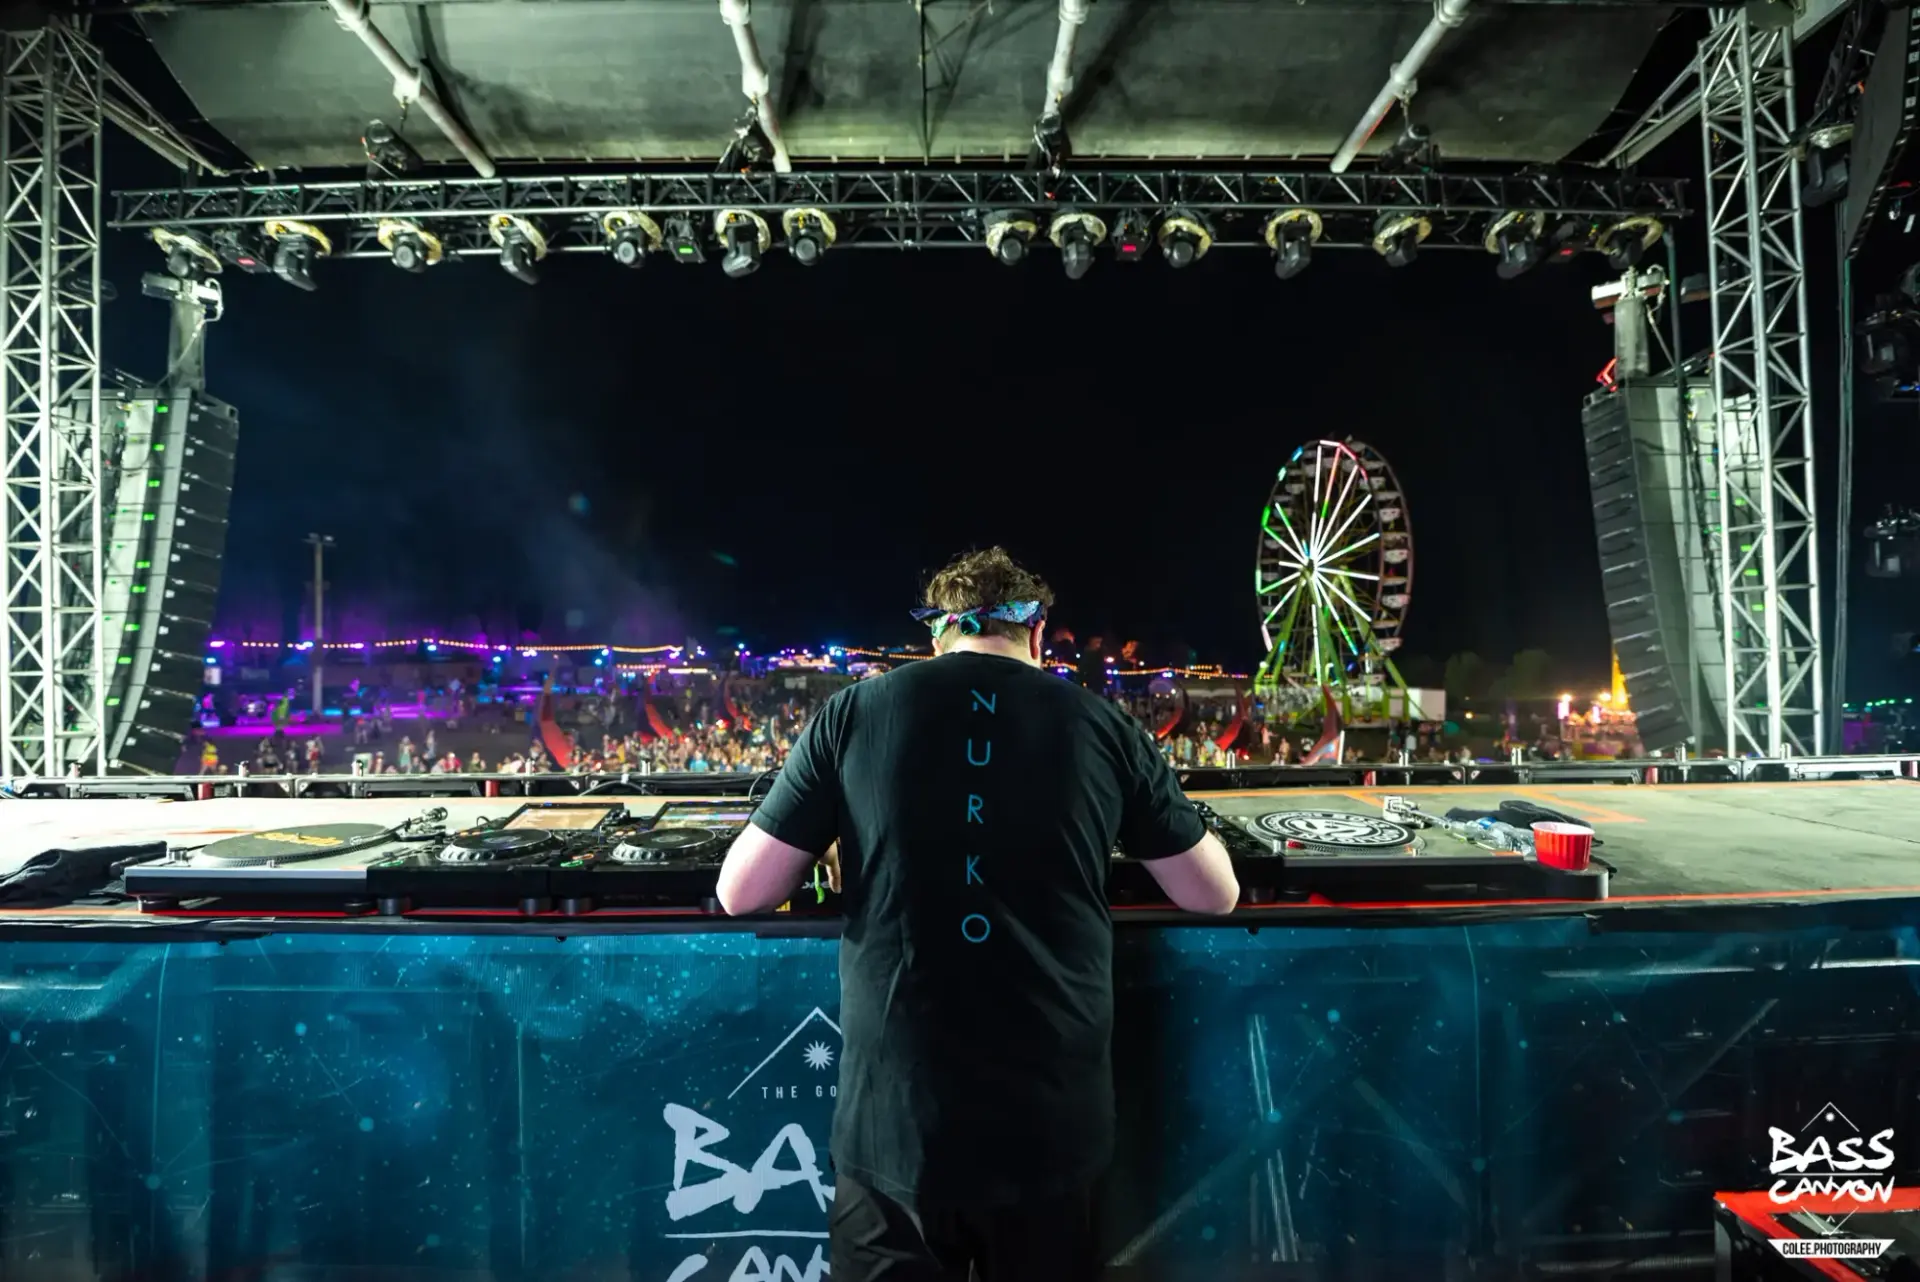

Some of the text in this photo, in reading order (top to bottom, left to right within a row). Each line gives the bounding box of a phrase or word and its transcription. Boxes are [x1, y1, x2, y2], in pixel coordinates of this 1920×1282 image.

[961, 689, 997, 943] NURKO
[762, 1086, 798, 1099] THE
[663, 1103, 836, 1221] BA
[665, 1245, 832, 1282] CAN
